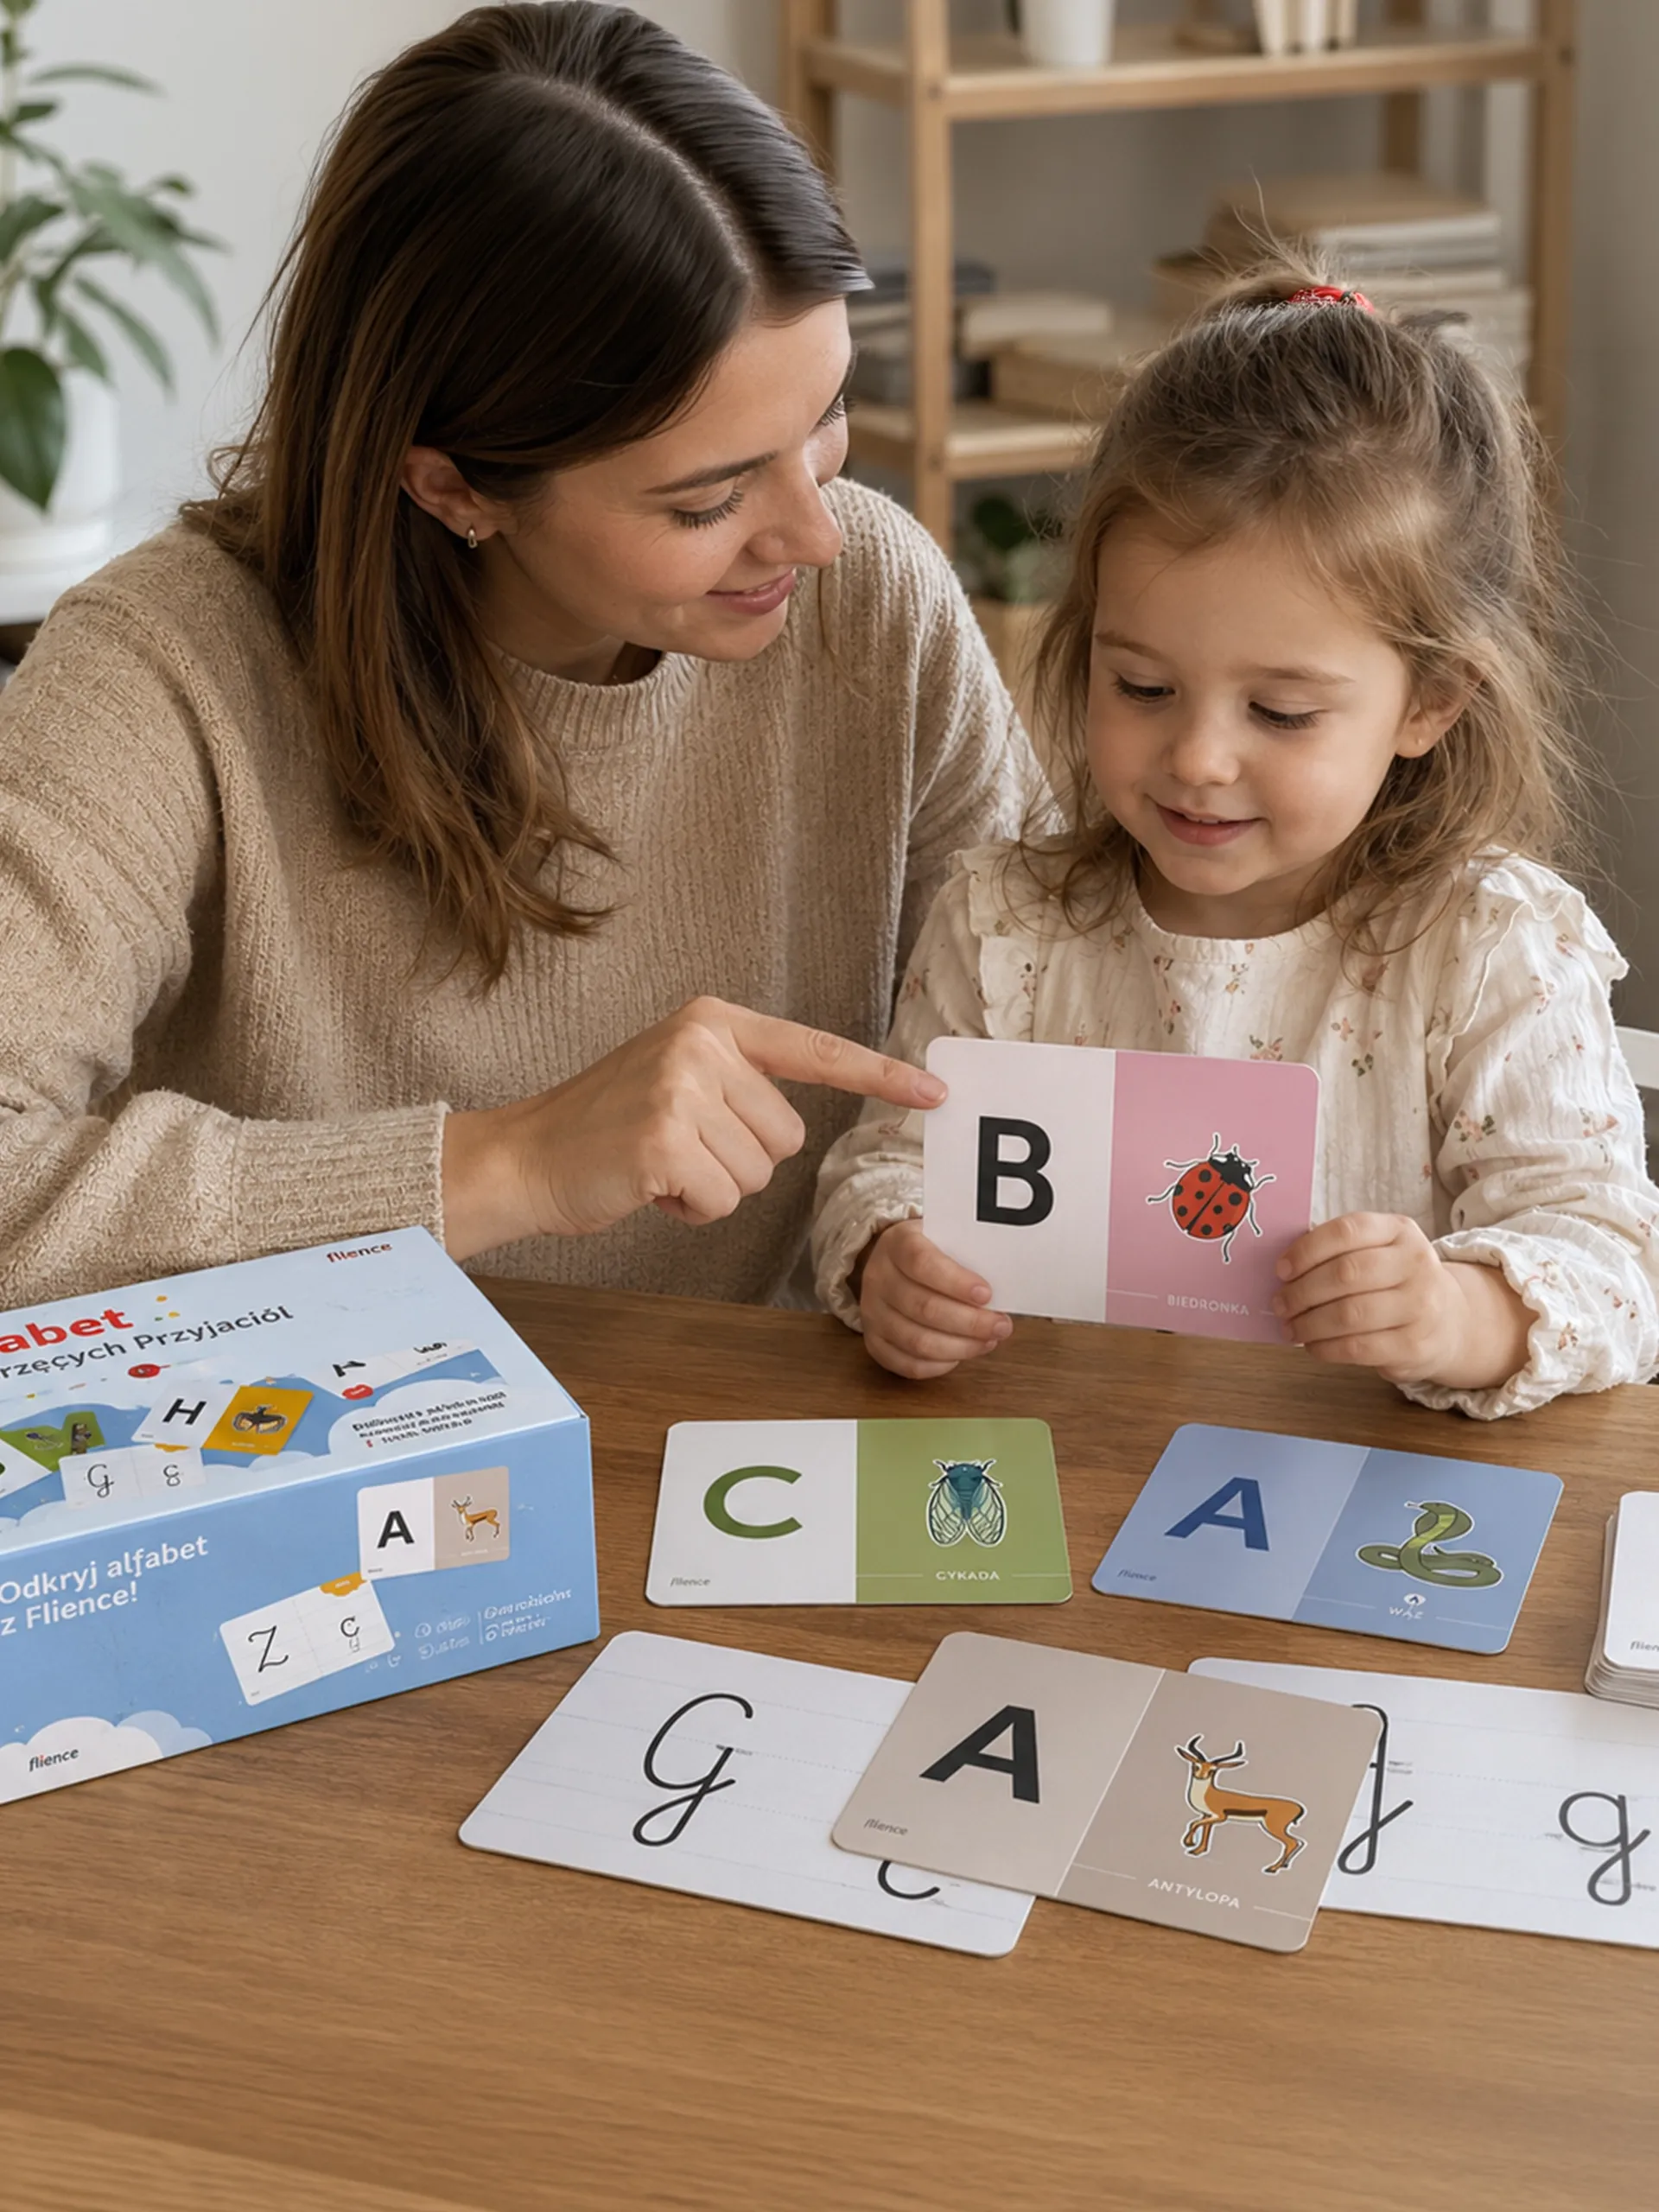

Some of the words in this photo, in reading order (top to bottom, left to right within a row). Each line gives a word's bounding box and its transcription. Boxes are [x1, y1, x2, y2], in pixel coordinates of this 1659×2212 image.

[976, 1115, 1054, 1227] B
[1166, 1294, 1249, 1315] BIEDRONKA
[162, 1398, 207, 1426] H
[376, 1510, 416, 1549] A
[702, 1465, 804, 1540] C
[1163, 1476, 1270, 1553] A
[0, 1560, 98, 1605] Odkryj
[107, 1535, 208, 1578] alfabet
[935, 1570, 1001, 1581] CYKADA
[0, 1617, 17, 1637] z
[26, 1580, 138, 1630] Flience!
[247, 1625, 289, 1674] Z
[29, 1747, 79, 1772] flience
[632, 1692, 754, 1847] G
[918, 1704, 1041, 1805] A
[1558, 1790, 1652, 1907] g
[1147, 1878, 1241, 1910] ANTYLOPA
